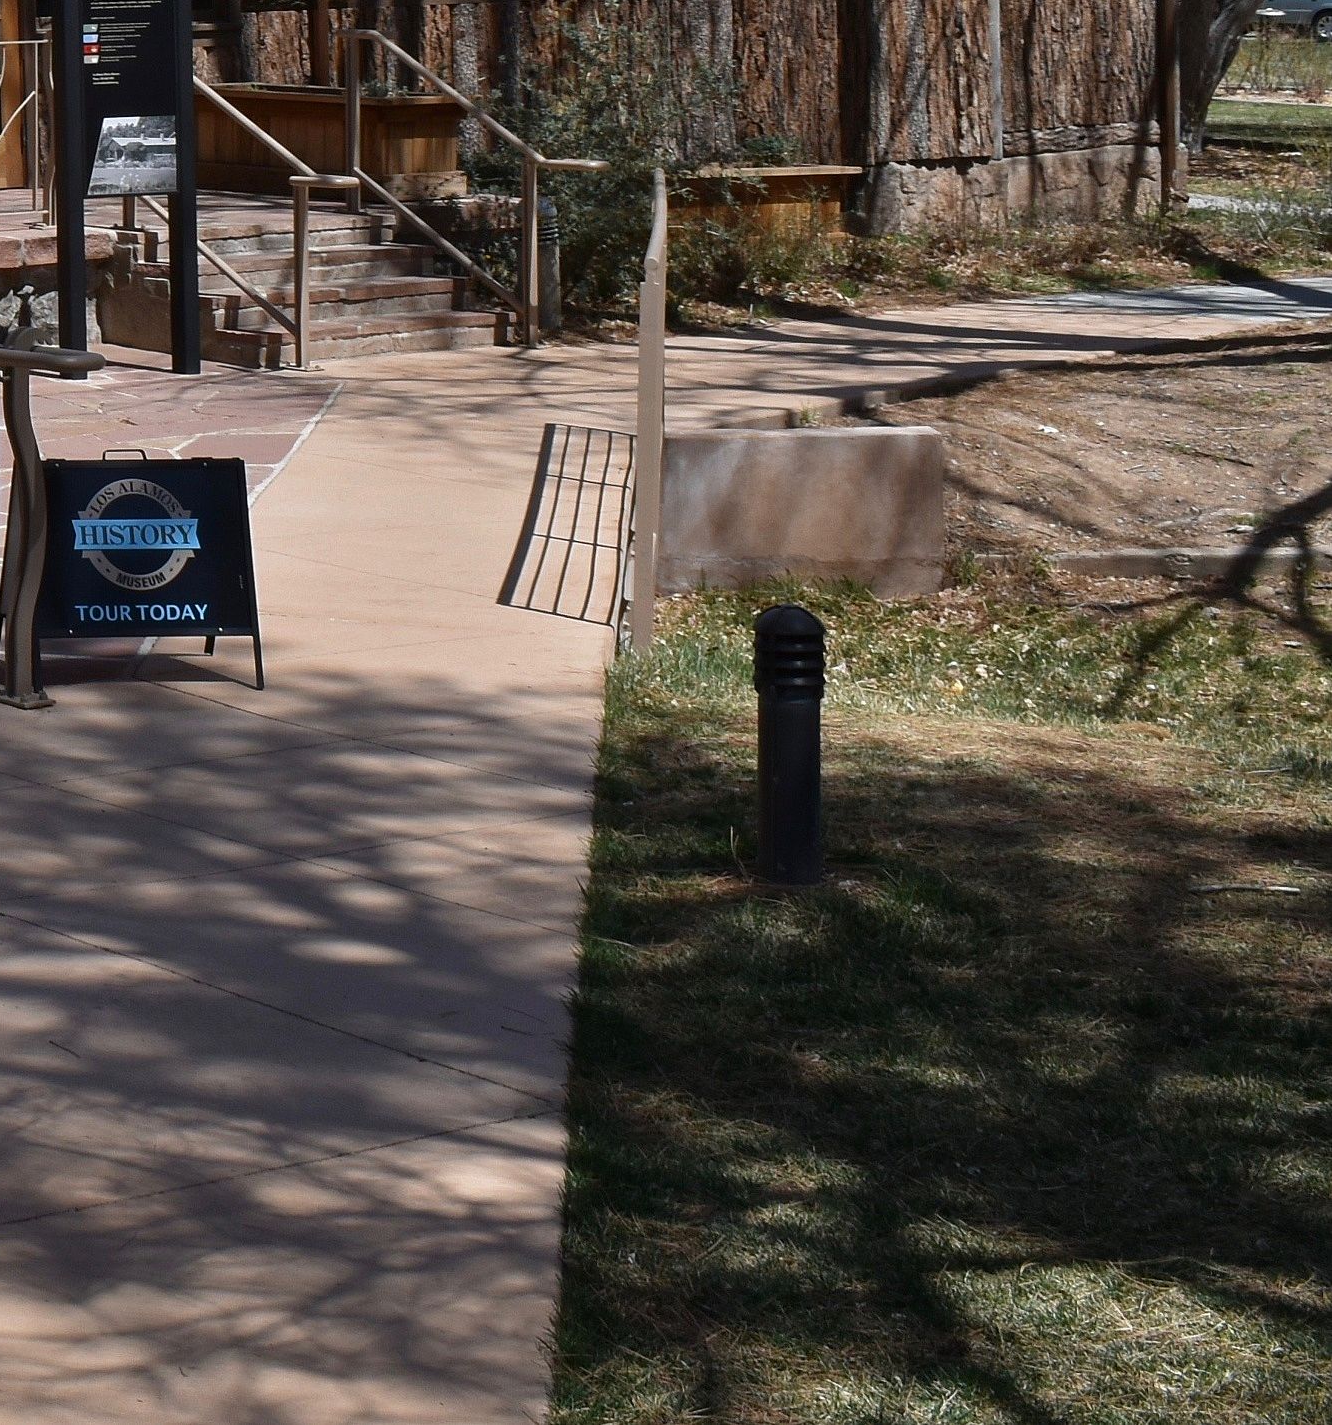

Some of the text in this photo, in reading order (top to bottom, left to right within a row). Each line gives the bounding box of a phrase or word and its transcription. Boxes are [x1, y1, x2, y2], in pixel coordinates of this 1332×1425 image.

[91, 481, 178, 514] LOS ALAMOS
[79, 524, 195, 546] HISTORY
[116, 572, 167, 588] MUSEUM
[75, 604, 208, 621] TOUR TODAY
